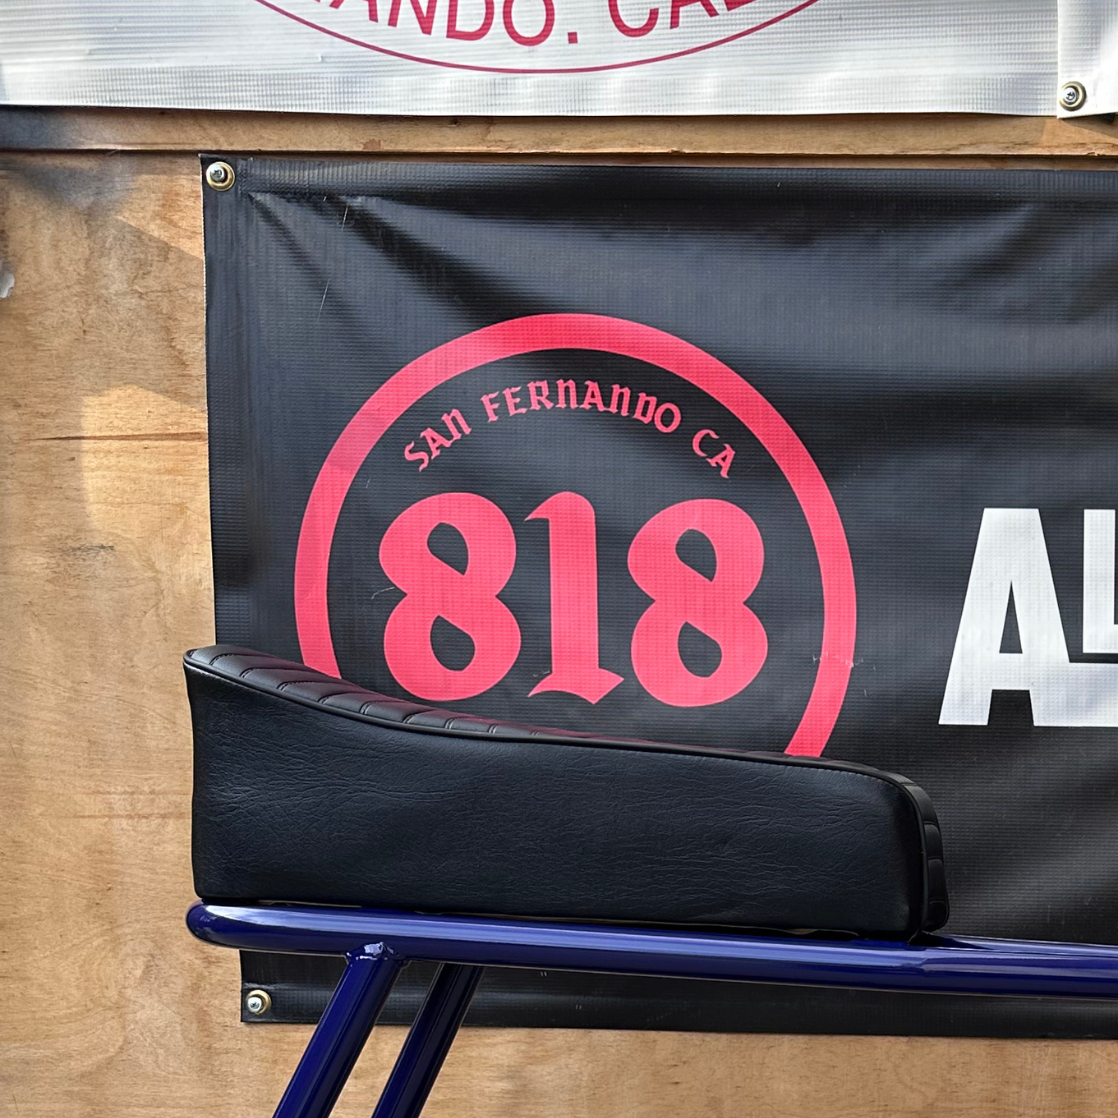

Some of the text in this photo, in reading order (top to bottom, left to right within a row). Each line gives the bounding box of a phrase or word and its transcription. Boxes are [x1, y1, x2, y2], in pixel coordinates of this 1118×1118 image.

[403, 379, 737, 479] SAN FERNANDO CA
[378, 490, 768, 708] 818
